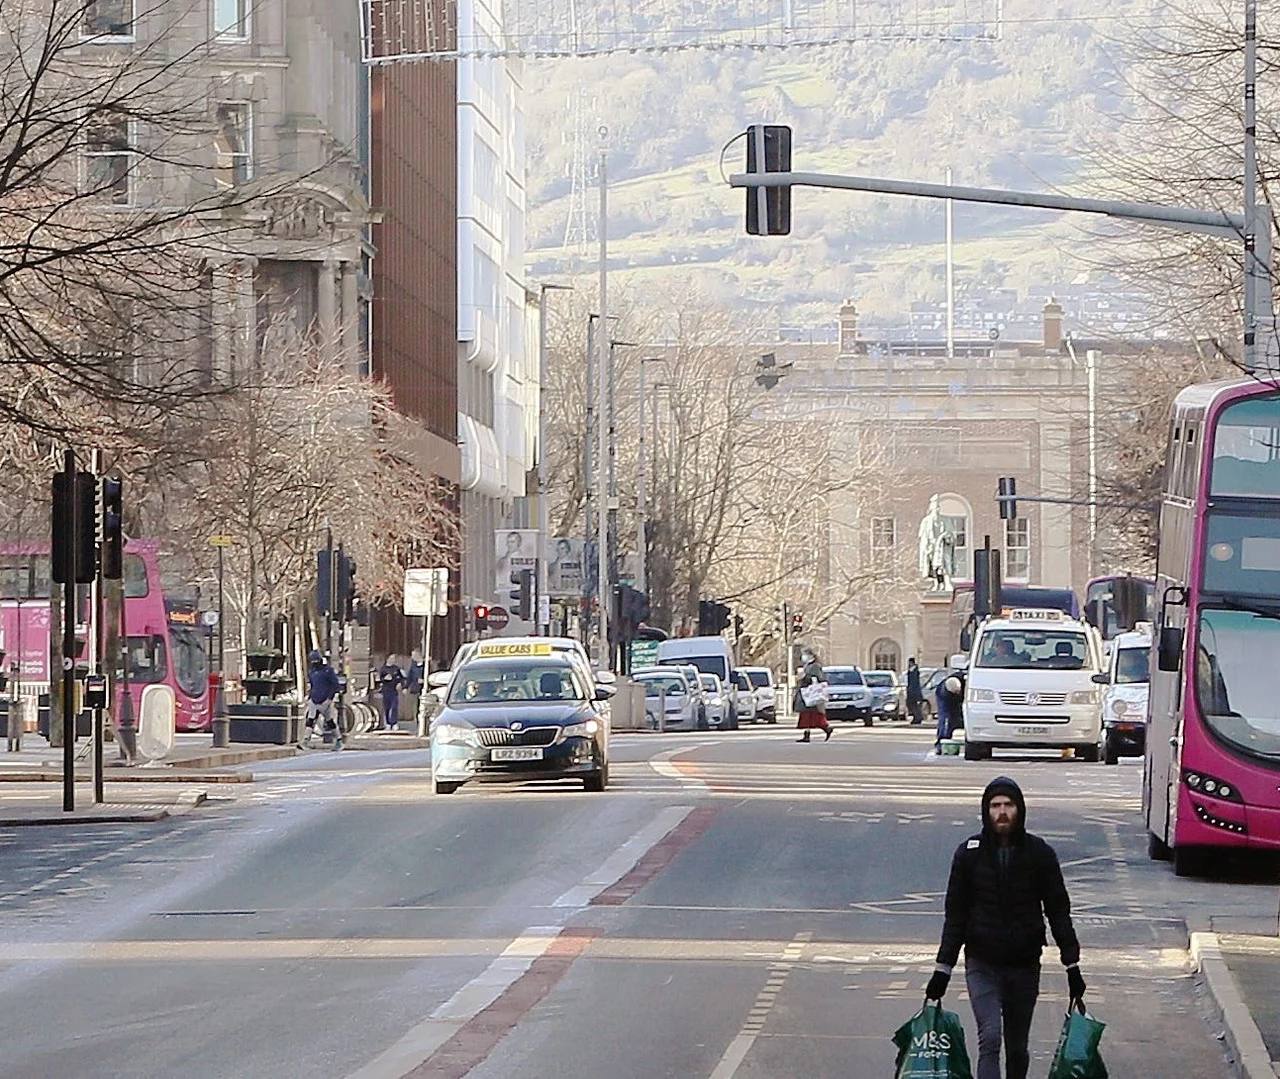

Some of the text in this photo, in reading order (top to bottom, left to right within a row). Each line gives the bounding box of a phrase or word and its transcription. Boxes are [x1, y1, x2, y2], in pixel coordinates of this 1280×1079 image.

[480, 644, 531, 654] VALUE CABS
[913, 1030, 951, 1049] M&S
